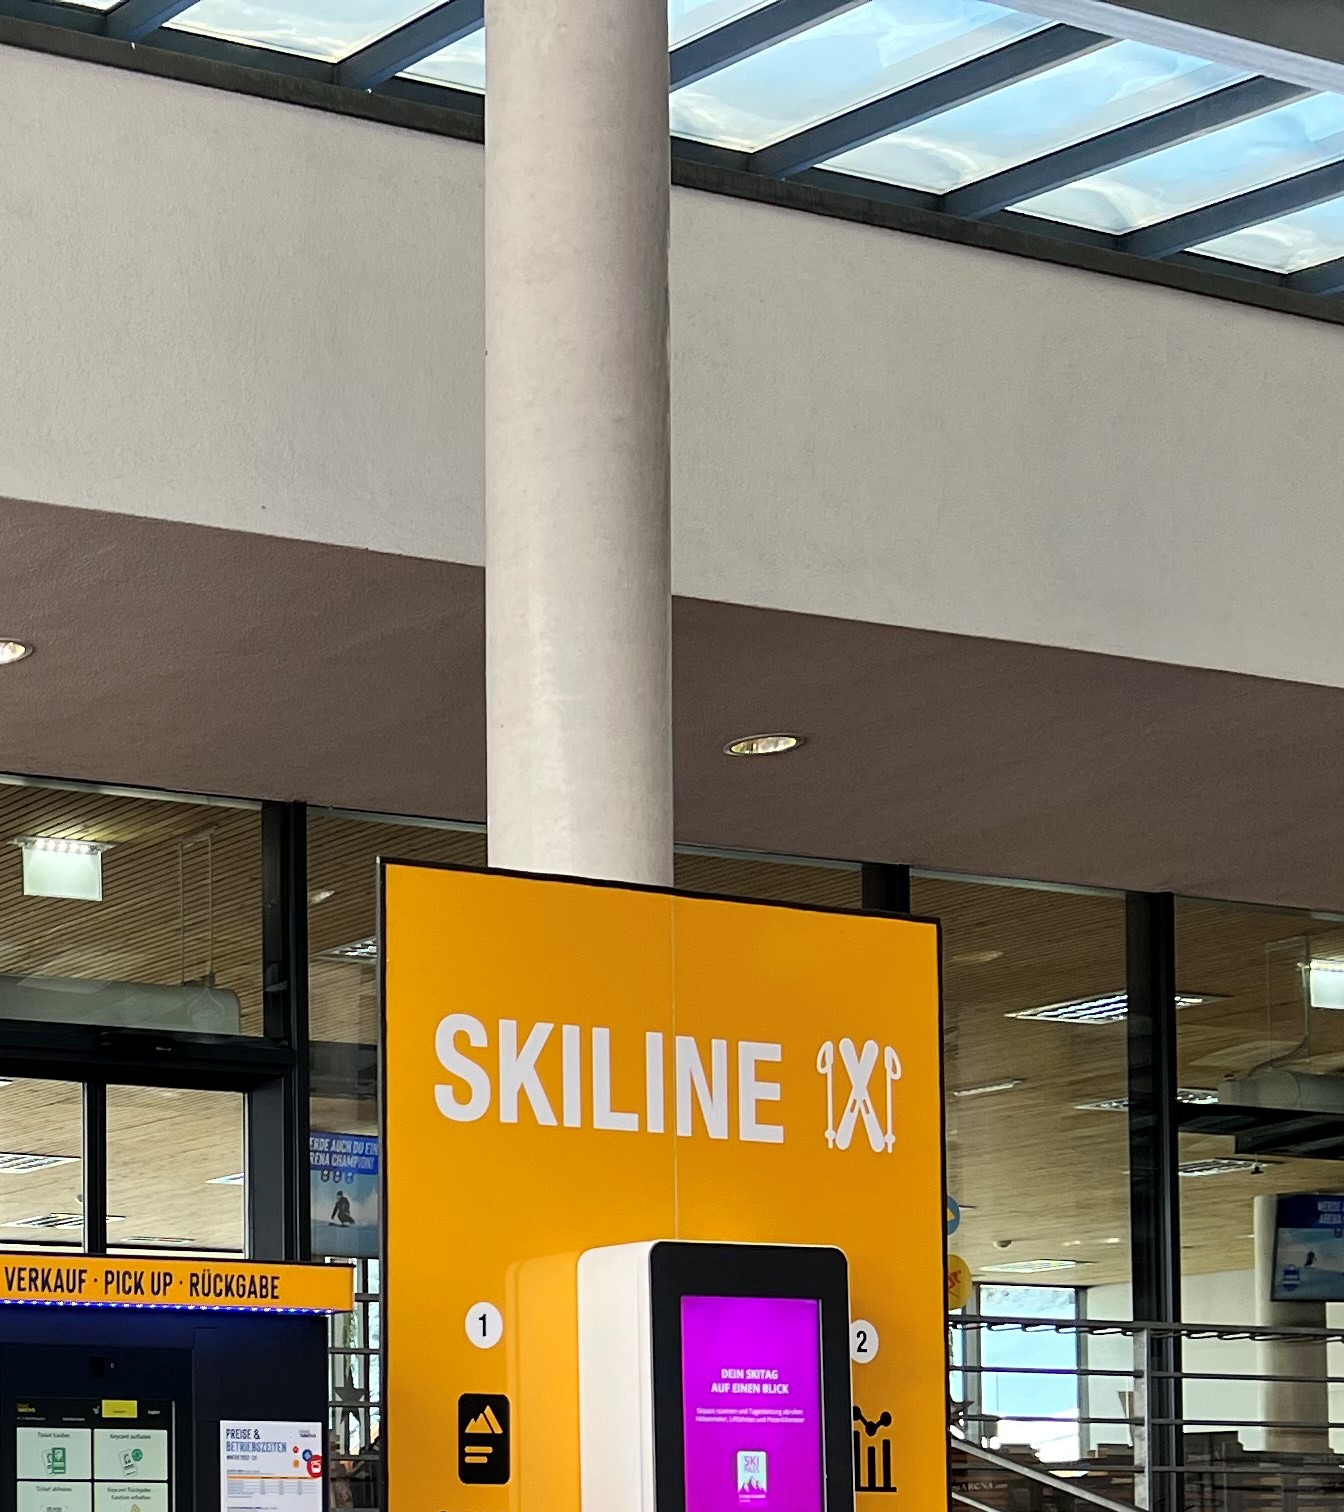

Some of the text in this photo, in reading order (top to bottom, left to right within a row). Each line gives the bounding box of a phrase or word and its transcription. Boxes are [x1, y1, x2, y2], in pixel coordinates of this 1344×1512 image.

[435, 1011, 784, 1145] SKILINE
[309, 1137, 329, 1152] ERDE
[310, 1152, 330, 1166] RENA
[4, 1265, 281, 1301] VERKAUF PICK UP RÜCKGABE
[478, 1314, 488, 1337] 1
[855, 1330, 868, 1353] 2
[720, 1368, 779, 1380] DEIN SKITAG
[711, 1382, 789, 1395] AUF EINEN BLICK
[225, 1428, 260, 1440] PREISE &
